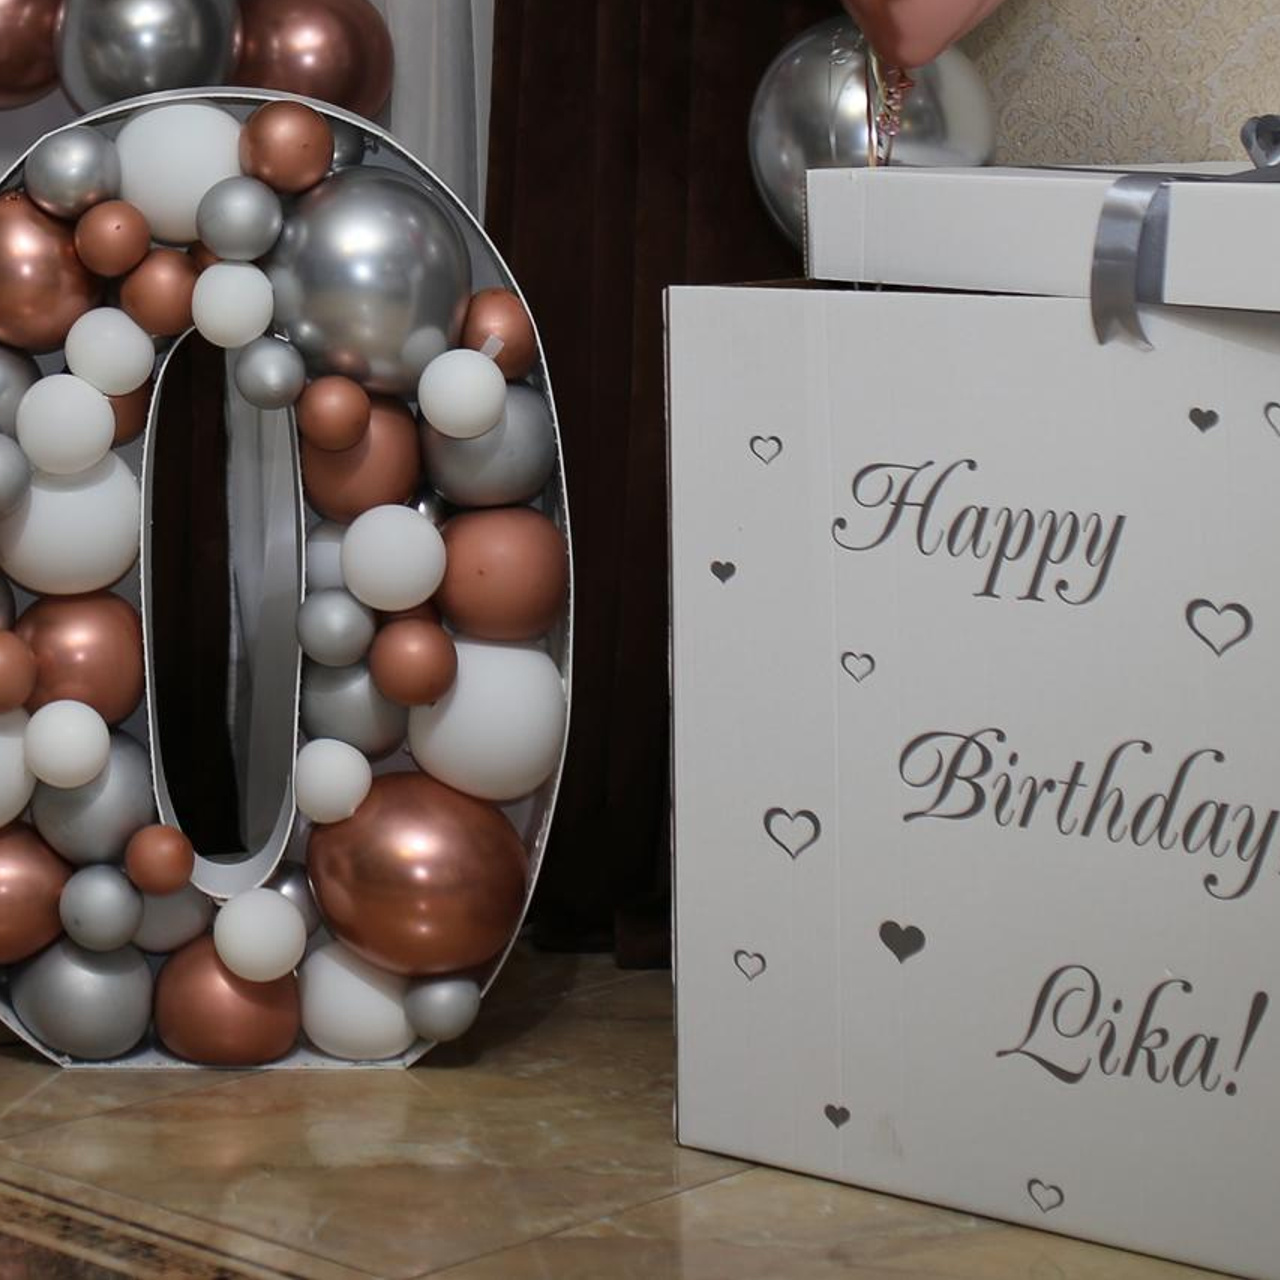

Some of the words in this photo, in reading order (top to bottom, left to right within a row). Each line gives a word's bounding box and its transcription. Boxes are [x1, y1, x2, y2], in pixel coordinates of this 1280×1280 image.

[831, 458, 1127, 606] Happy
[897, 727, 1280, 901] Birthday
[995, 963, 1270, 1097] Lika!
